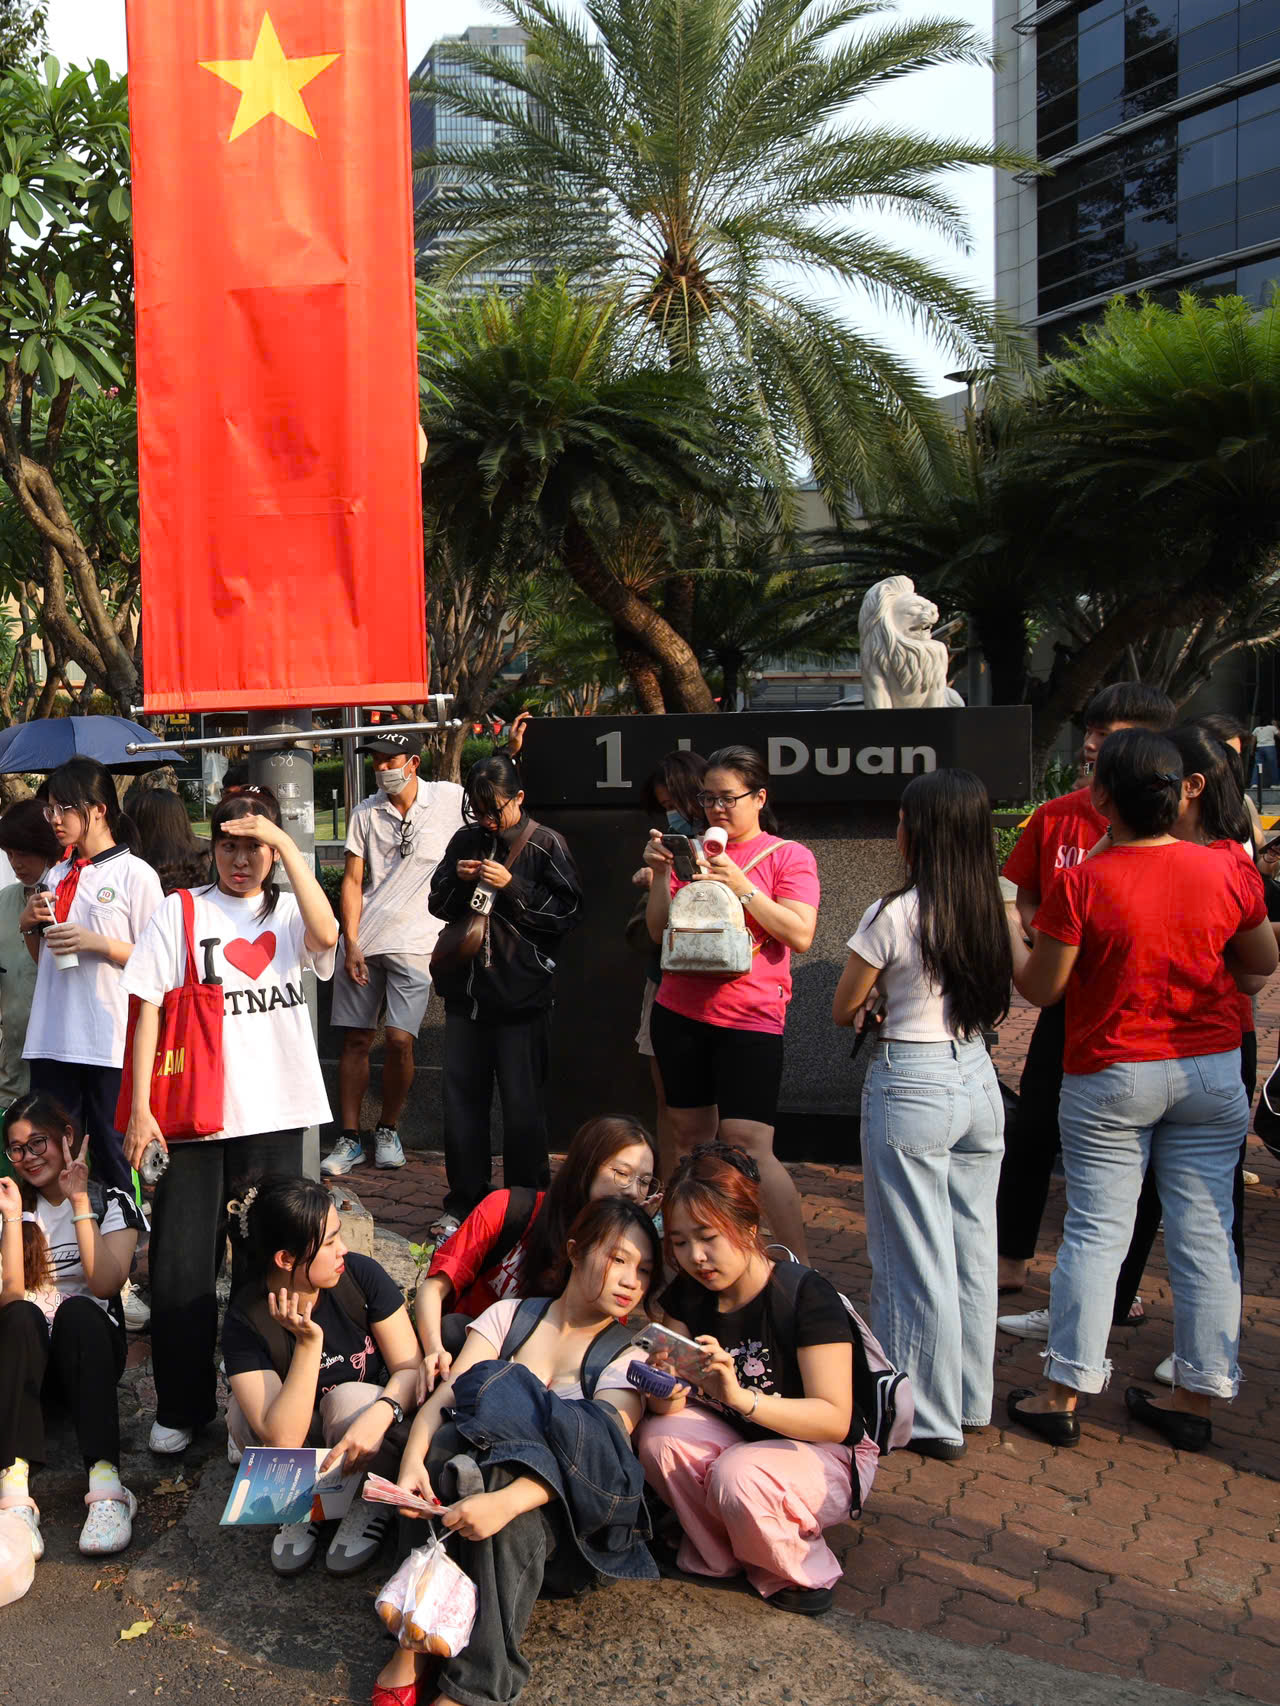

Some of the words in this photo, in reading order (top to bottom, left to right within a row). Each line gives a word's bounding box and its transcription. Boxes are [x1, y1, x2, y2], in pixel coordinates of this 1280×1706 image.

[596, 731, 633, 788] 1
[767, 736, 937, 776] Duan
[200, 937, 223, 985] I
[223, 980, 307, 1017] TNAM
